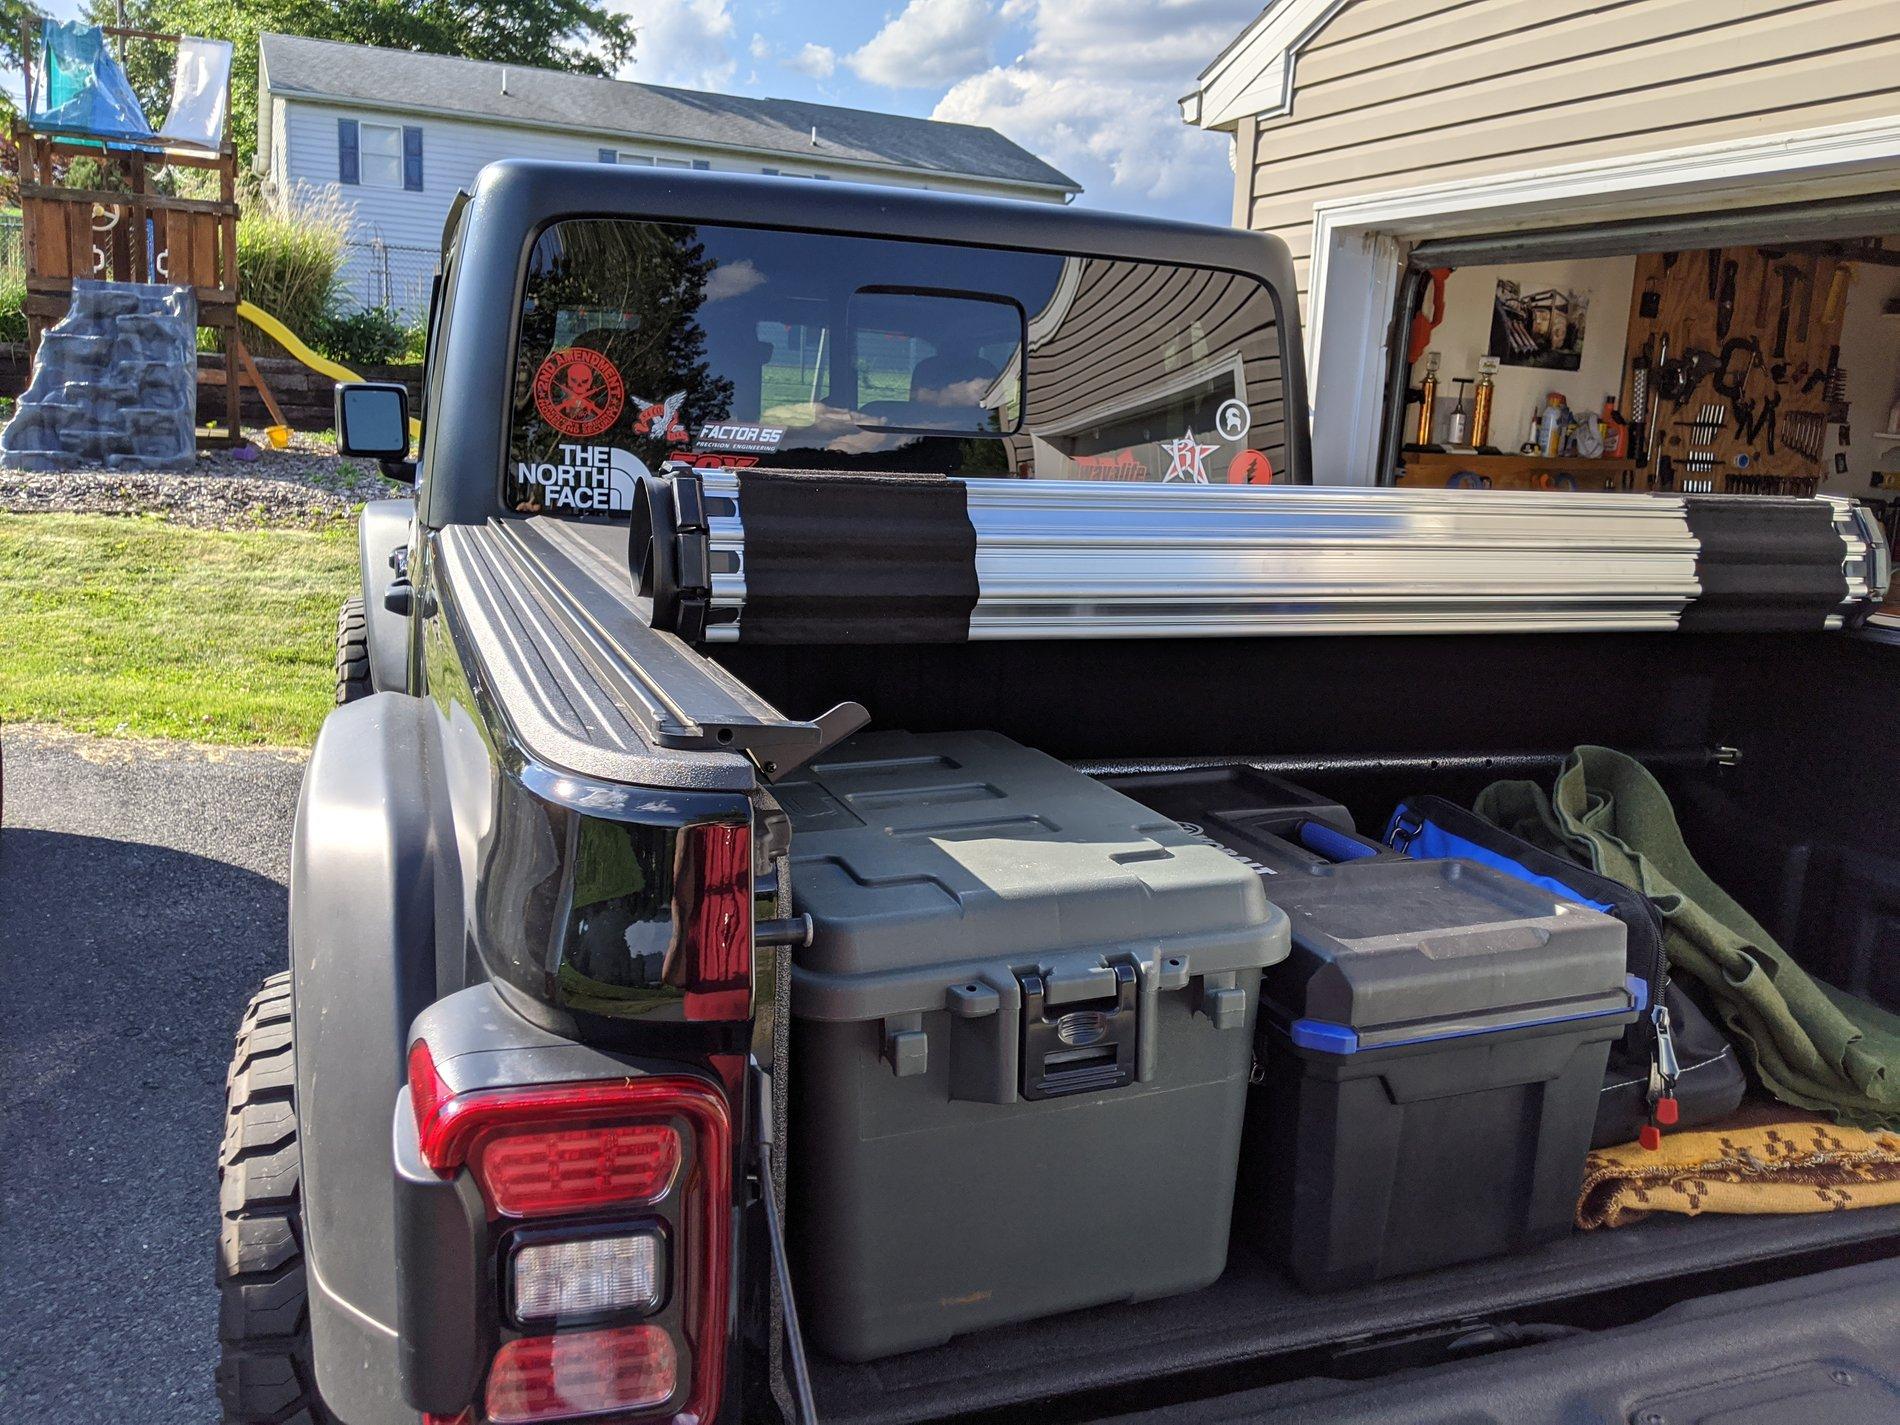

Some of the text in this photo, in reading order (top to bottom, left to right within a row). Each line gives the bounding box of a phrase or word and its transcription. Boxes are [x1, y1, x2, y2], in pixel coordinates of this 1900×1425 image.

[536, 350, 621, 398] 2ND AMENDMENT
[538, 398, 579, 434] HOMELAND
[582, 405, 619, 435] SECURITY
[700, 425, 758, 441] FACTOR
[759, 429, 782, 442] 55
[559, 444, 608, 467] THE
[696, 441, 776, 452] PRECISION ENGINEERING
[518, 462, 609, 488] NORTH
[544, 486, 608, 509] FACE
